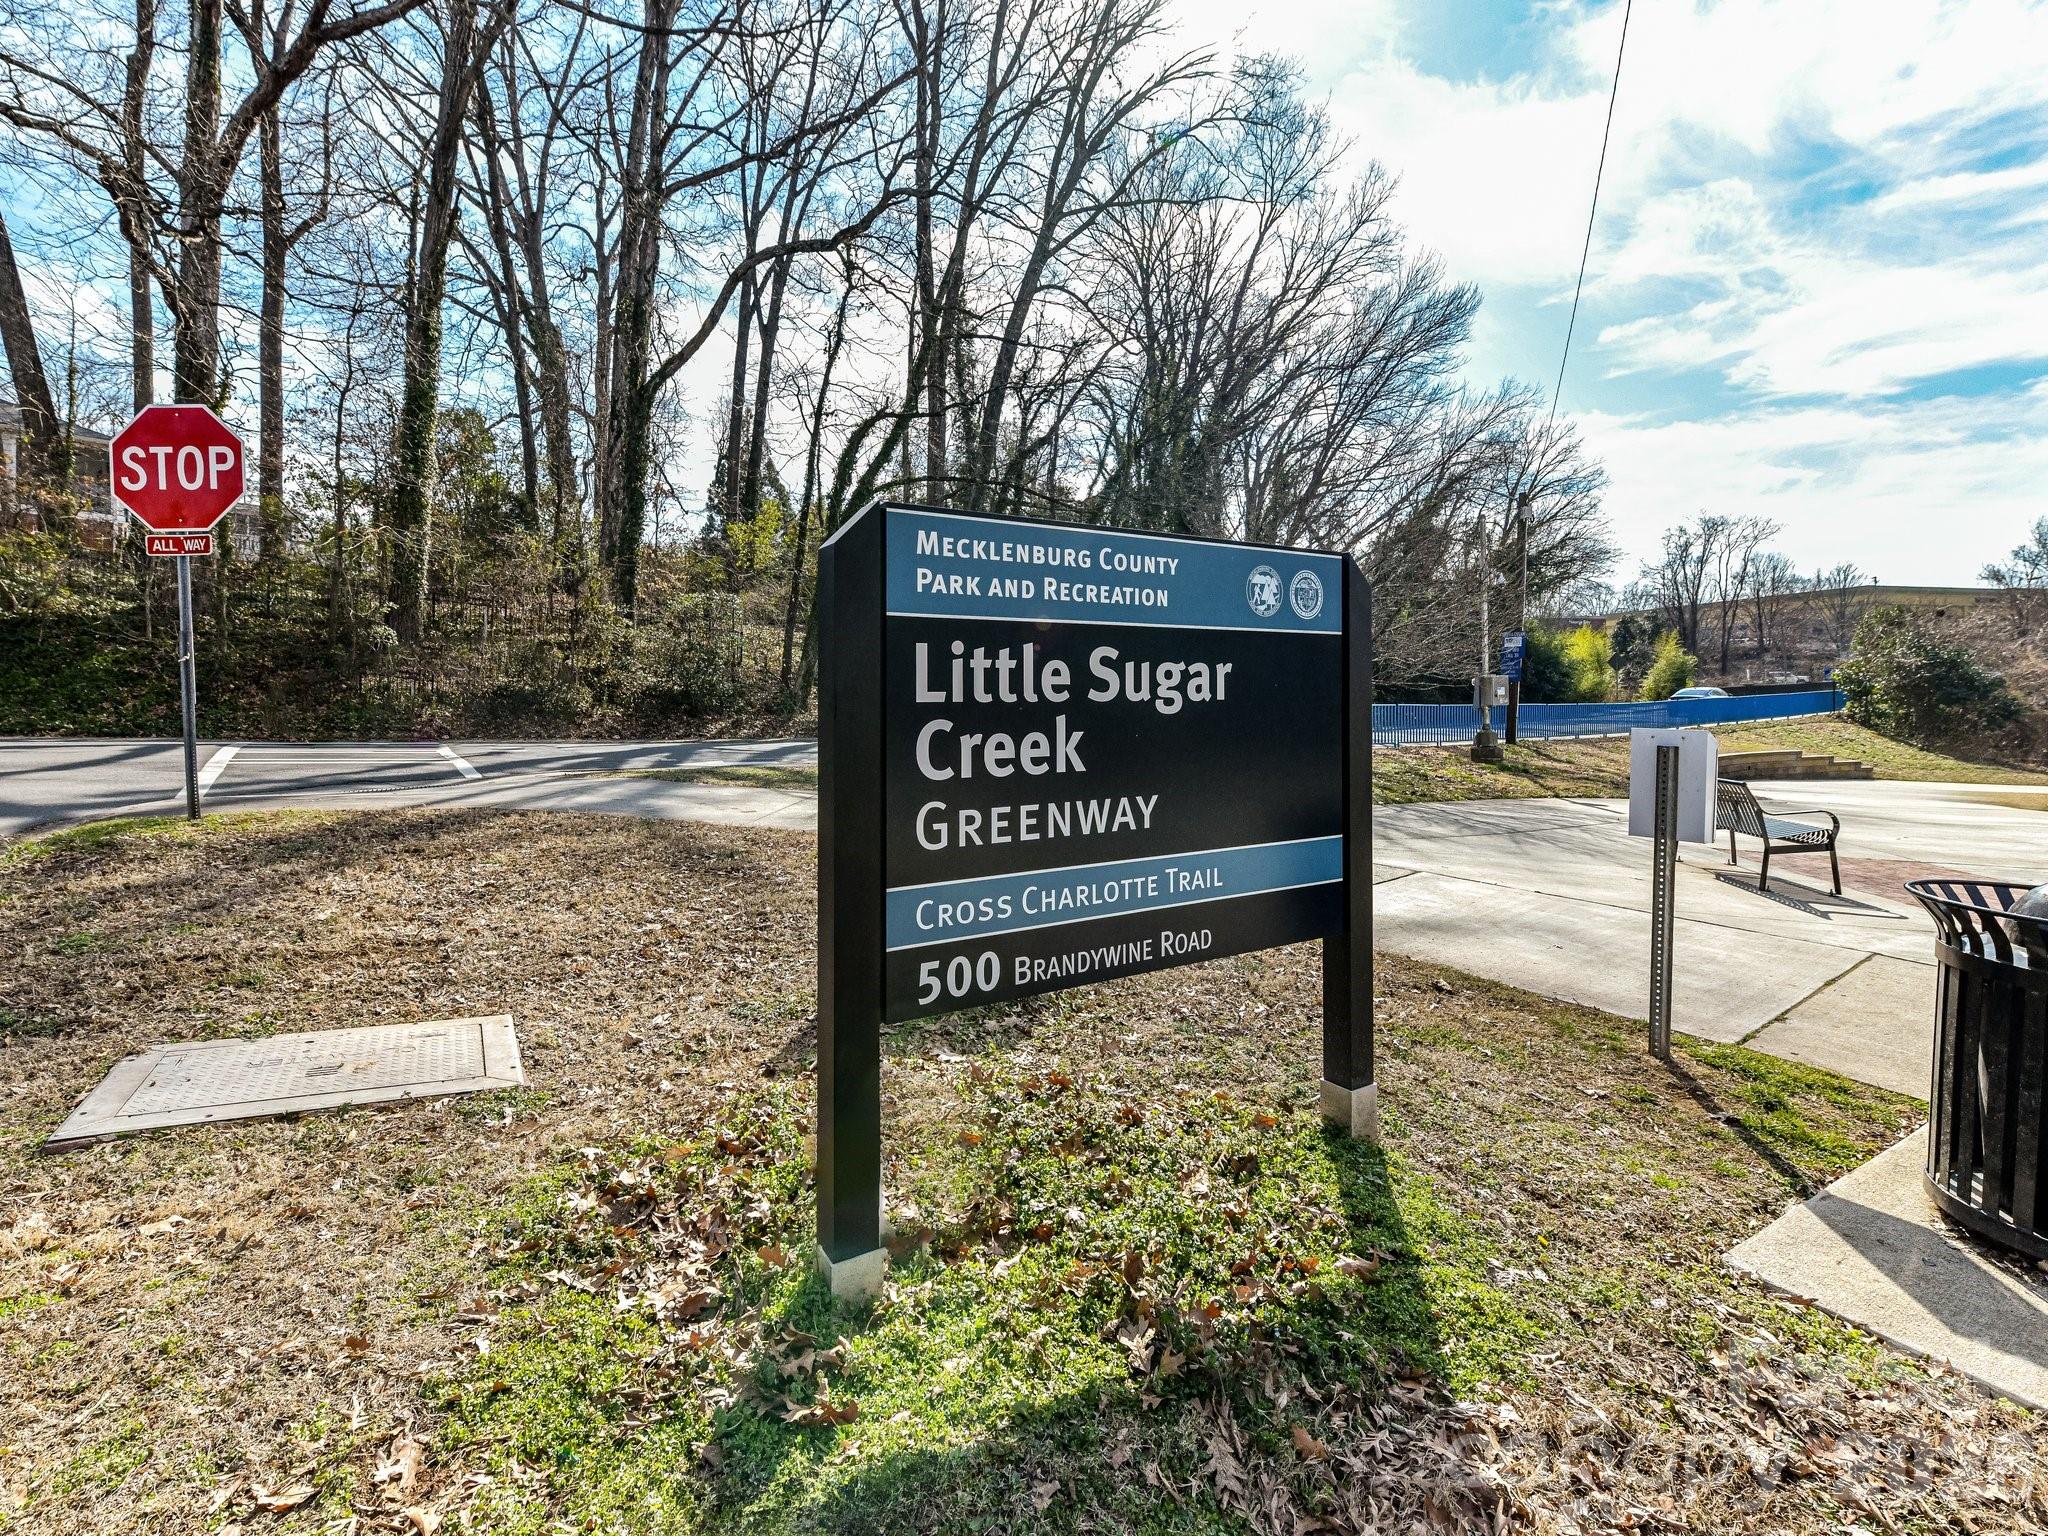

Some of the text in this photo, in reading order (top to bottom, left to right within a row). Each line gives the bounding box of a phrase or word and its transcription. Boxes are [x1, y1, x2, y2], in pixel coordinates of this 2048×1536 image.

[121, 445, 235, 491] STOP
[152, 539, 206, 551] ALL WAY
[917, 529, 1178, 575] MECKLENBURG COUNTY
[917, 568, 1167, 606] PARK AND RECREATION
[916, 641, 1232, 714] Little Sugar
[916, 714, 1086, 780] Creek
[916, 795, 1158, 850] GREENWAY
[916, 868, 1222, 931] CROSS CHARLOTTE TRAIL
[919, 930, 1211, 1005] 500 BRANDYWINE ROAD
